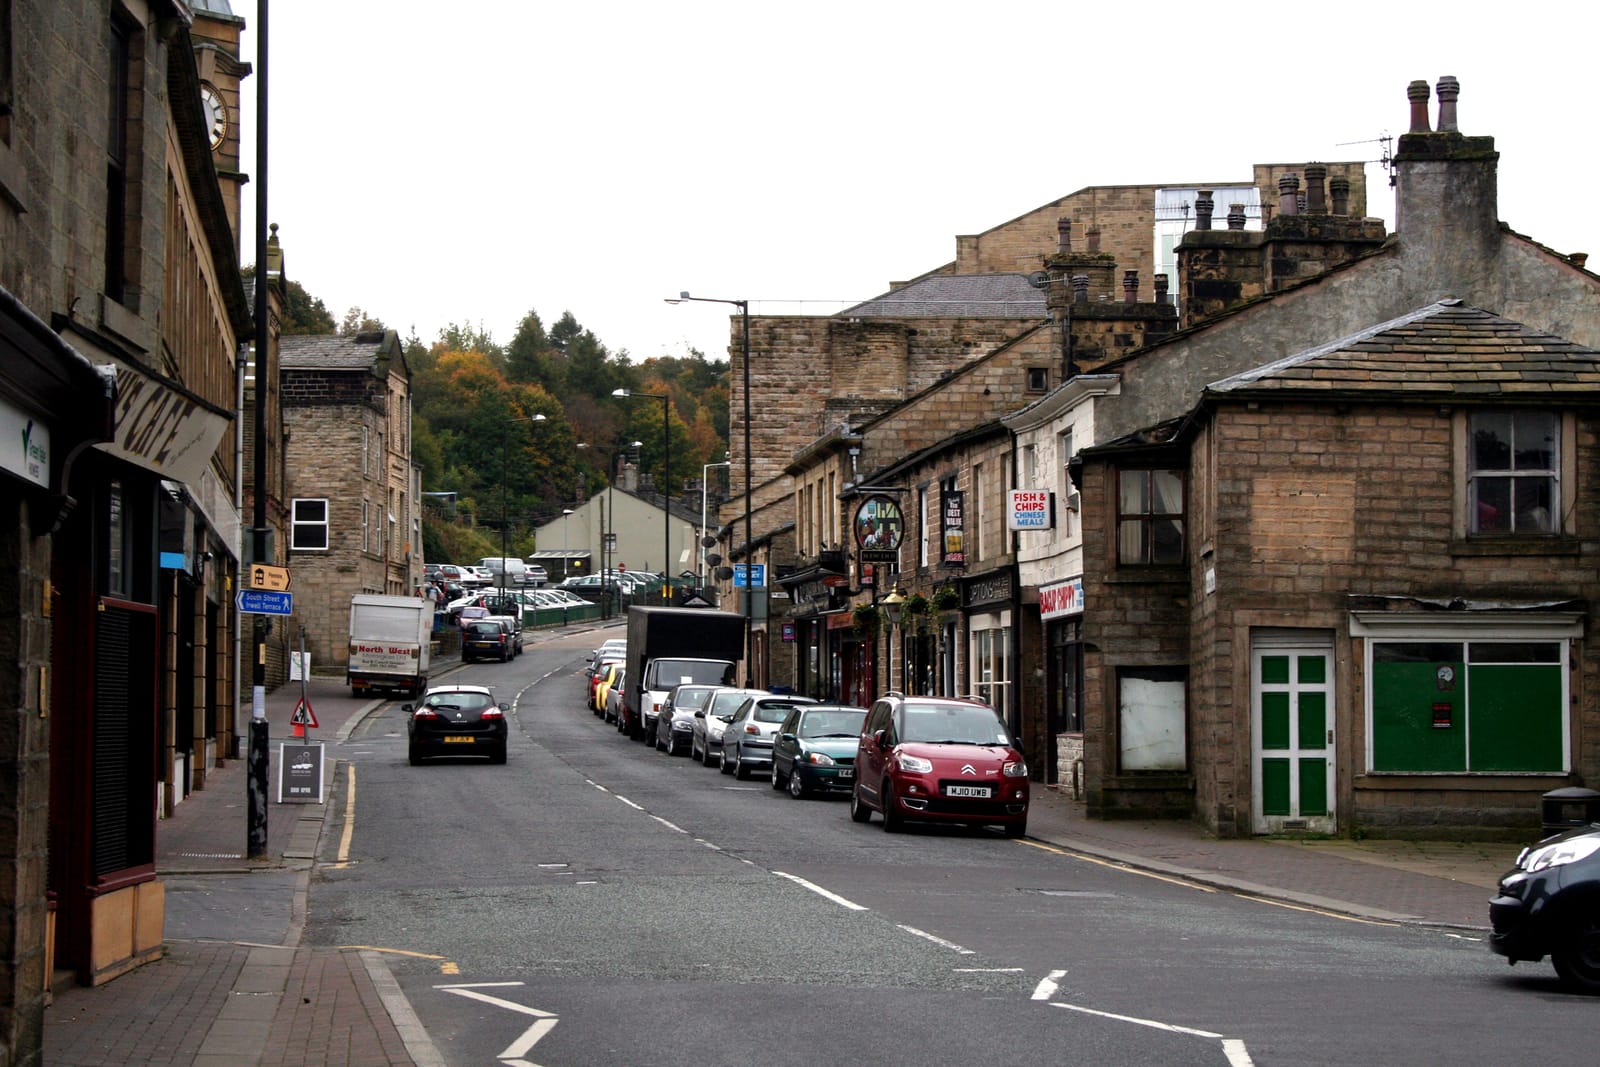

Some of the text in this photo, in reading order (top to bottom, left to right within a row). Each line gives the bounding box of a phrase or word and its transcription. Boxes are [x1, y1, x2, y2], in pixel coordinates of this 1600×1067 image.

[123, 385, 197, 466] CAFE
[1014, 493, 1046, 501] FISH &
[1015, 502, 1045, 511] CHIPS
[1014, 511, 1046, 519] CHINESE
[1017, 518, 1044, 526] MEALS
[263, 594, 281, 602] Street
[262, 602, 282, 611] Terrace
[359, 645, 410, 655] North West
[951, 787, 987, 797] MJ10 UWB
